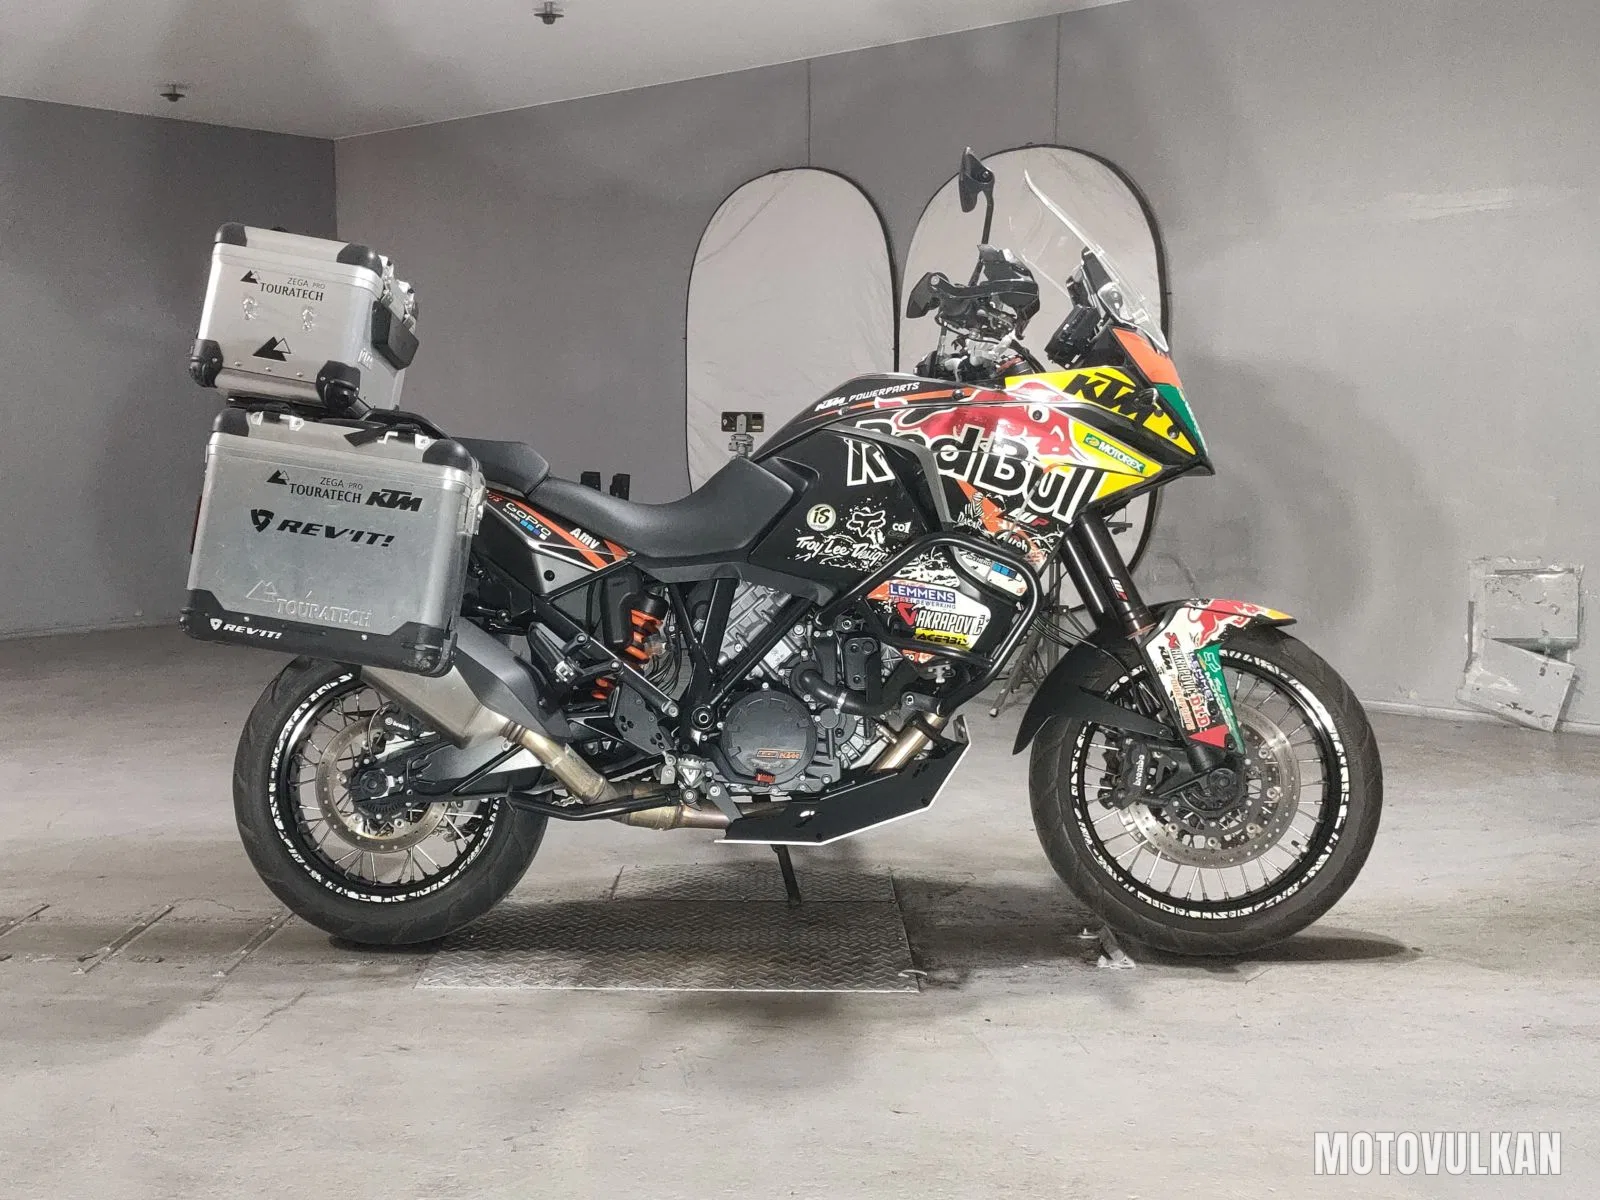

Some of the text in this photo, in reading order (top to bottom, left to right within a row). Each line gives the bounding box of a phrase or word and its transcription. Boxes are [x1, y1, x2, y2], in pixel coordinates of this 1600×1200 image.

[259, 282, 324, 302] TOURATECH
[287, 276, 326, 290] ZEGA PRO
[849, 382, 920, 402] POWERPARTS
[1062, 372, 1154, 426] KTM
[1098, 441, 1145, 474] MOTOREX
[320, 476, 364, 490] ZEGA PRO
[973, 431, 1104, 525] Bull
[289, 483, 423, 512] TOURATECH KTM
[506, 502, 552, 537] GoPro
[796, 535, 824, 558] Troy
[825, 540, 850, 556] Lee
[890, 585, 956, 603] LEMMENS
[276, 598, 372, 628] TOURATECH
[1133, 754, 1145, 787] brembo
